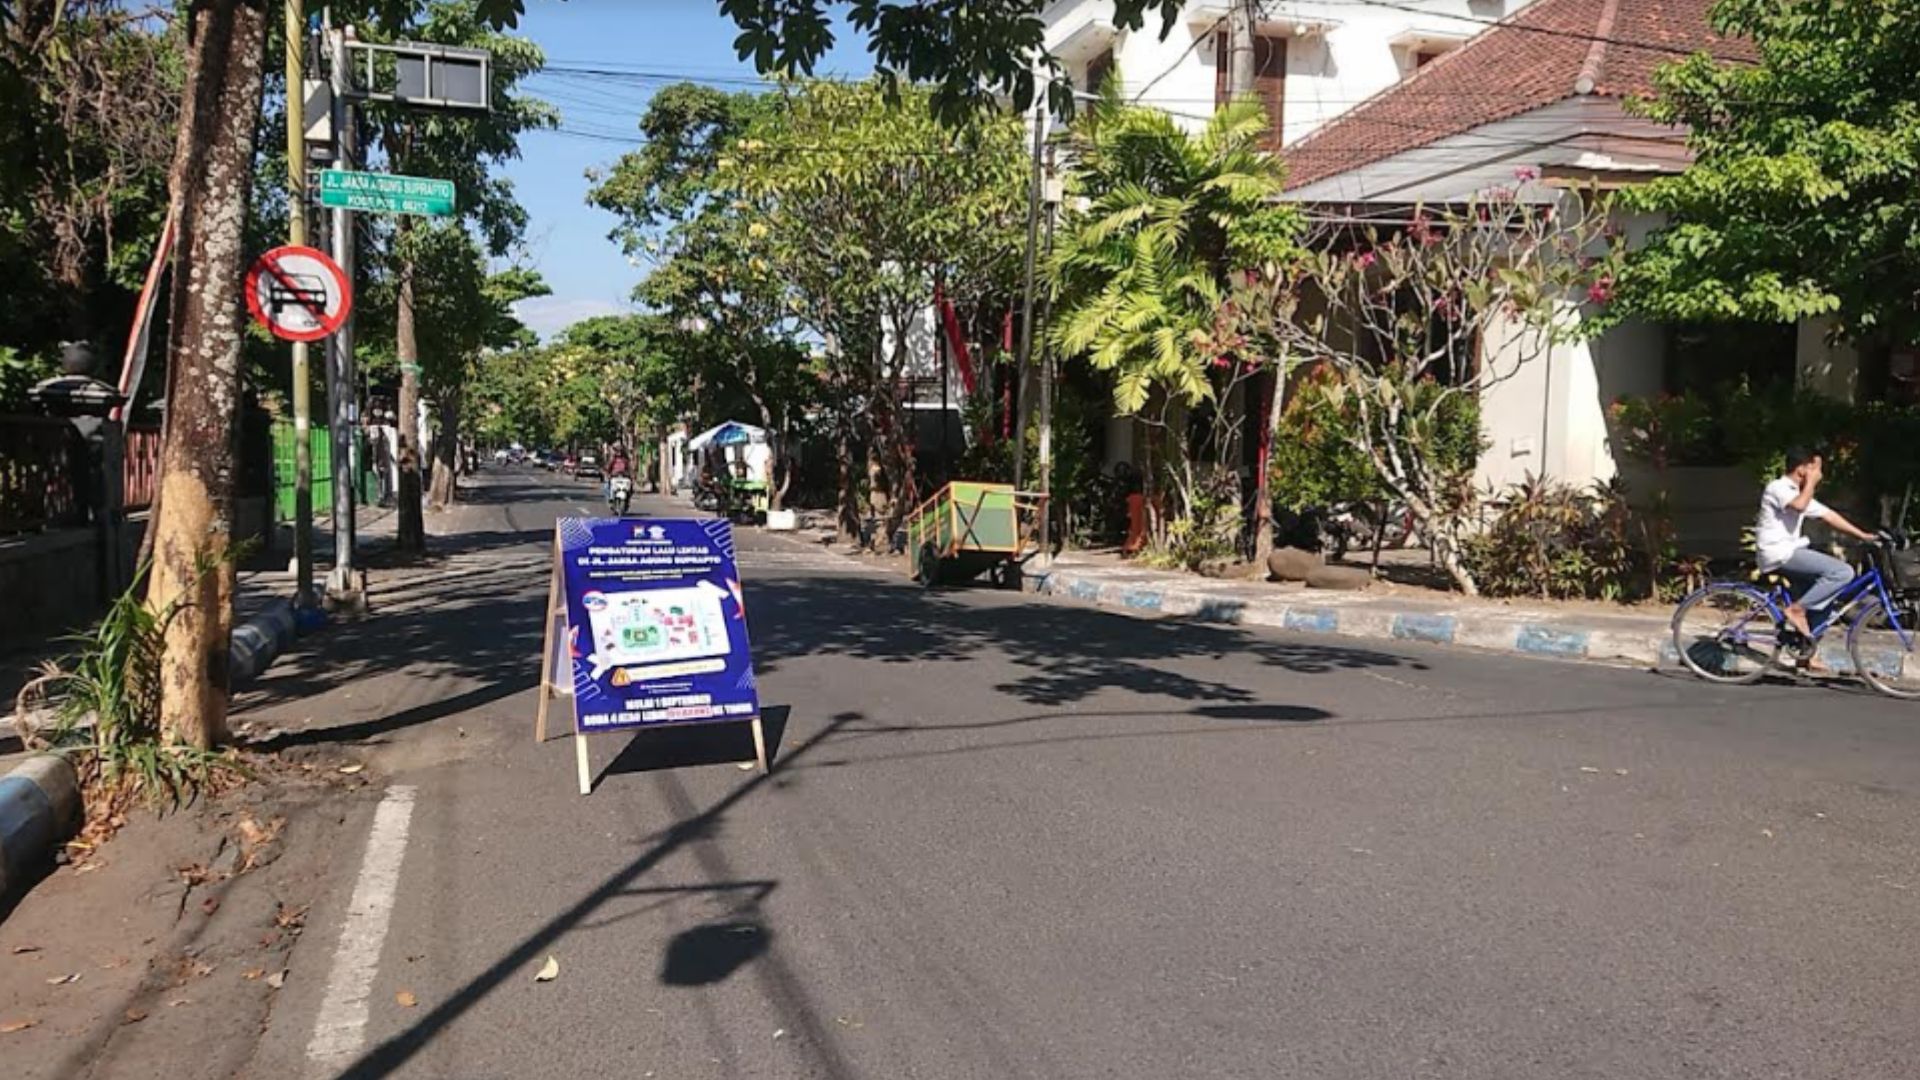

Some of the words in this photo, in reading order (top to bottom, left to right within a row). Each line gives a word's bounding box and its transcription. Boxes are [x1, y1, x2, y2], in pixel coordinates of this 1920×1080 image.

[652, 546, 675, 554] LALU
[676, 546, 709, 554] LINTAS
[639, 555, 673, 564] AGUNG
[674, 555, 721, 564] SUPRAPTO
